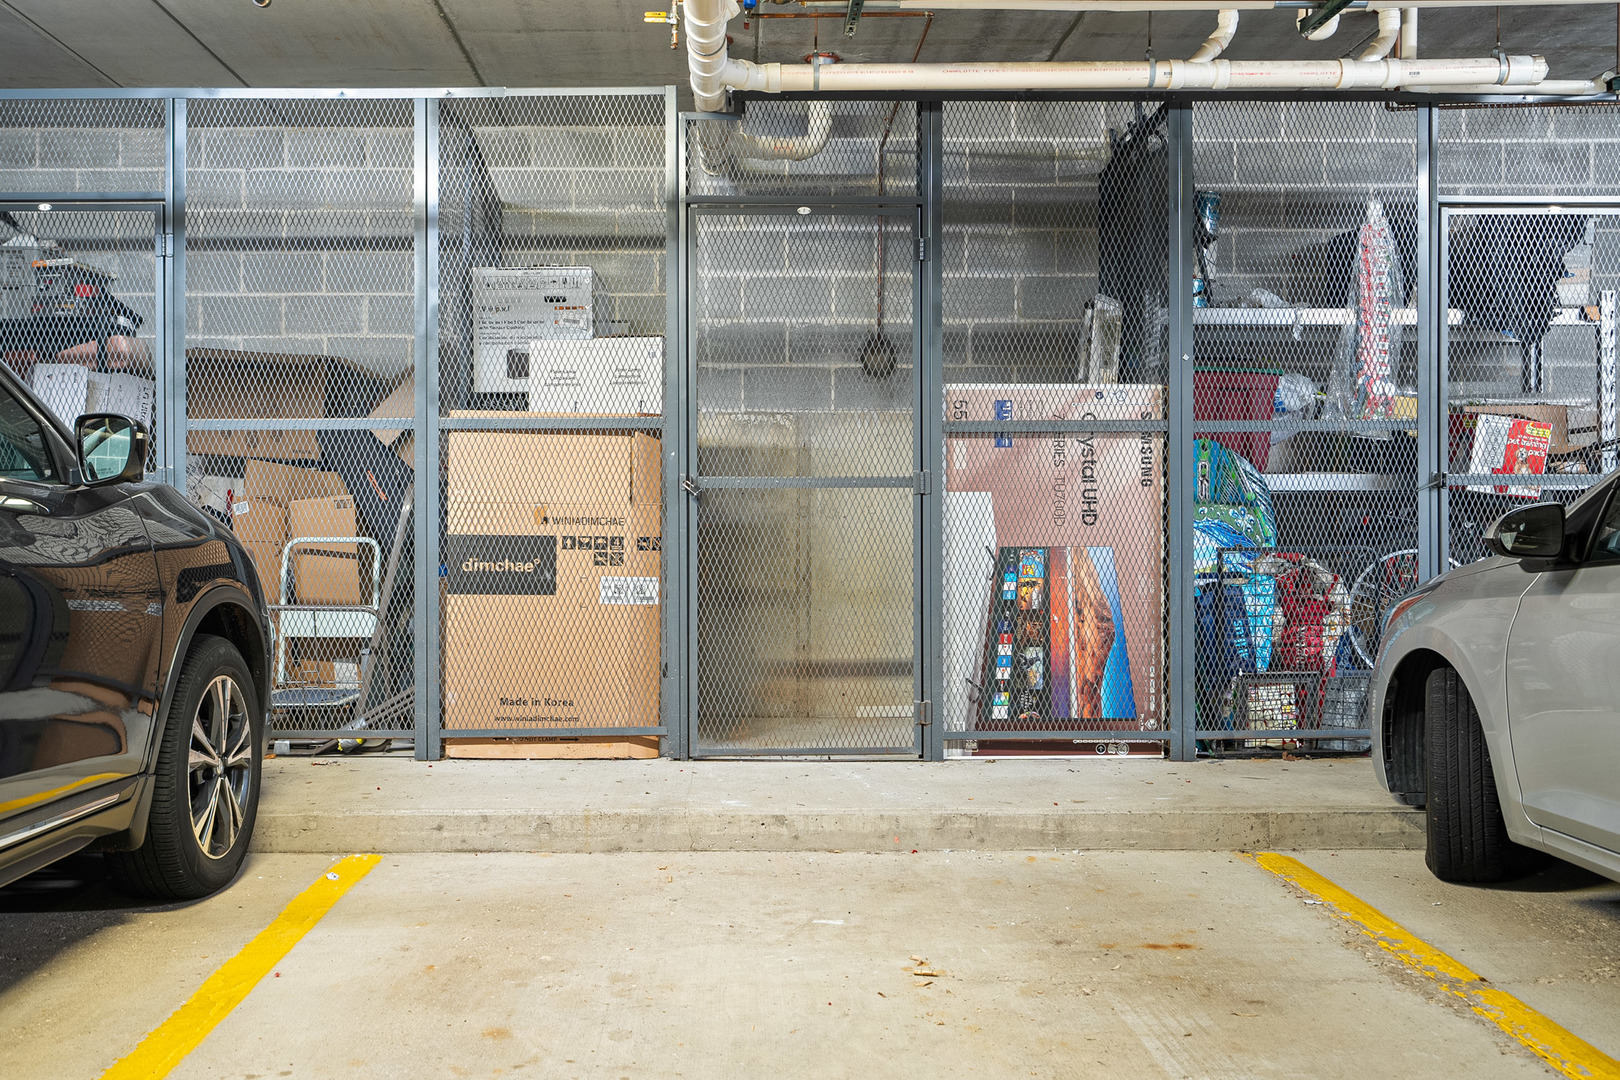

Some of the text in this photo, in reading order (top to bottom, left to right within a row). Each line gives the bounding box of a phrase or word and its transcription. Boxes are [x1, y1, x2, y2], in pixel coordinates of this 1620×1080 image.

[953, 400, 968, 420] 55
[1053, 423, 1065, 467] ERIES
[1141, 412, 1152, 487] SMSUNG
[1076, 412, 1097, 526] Cystal UHD
[499, 697, 574, 707] Made in Korea
